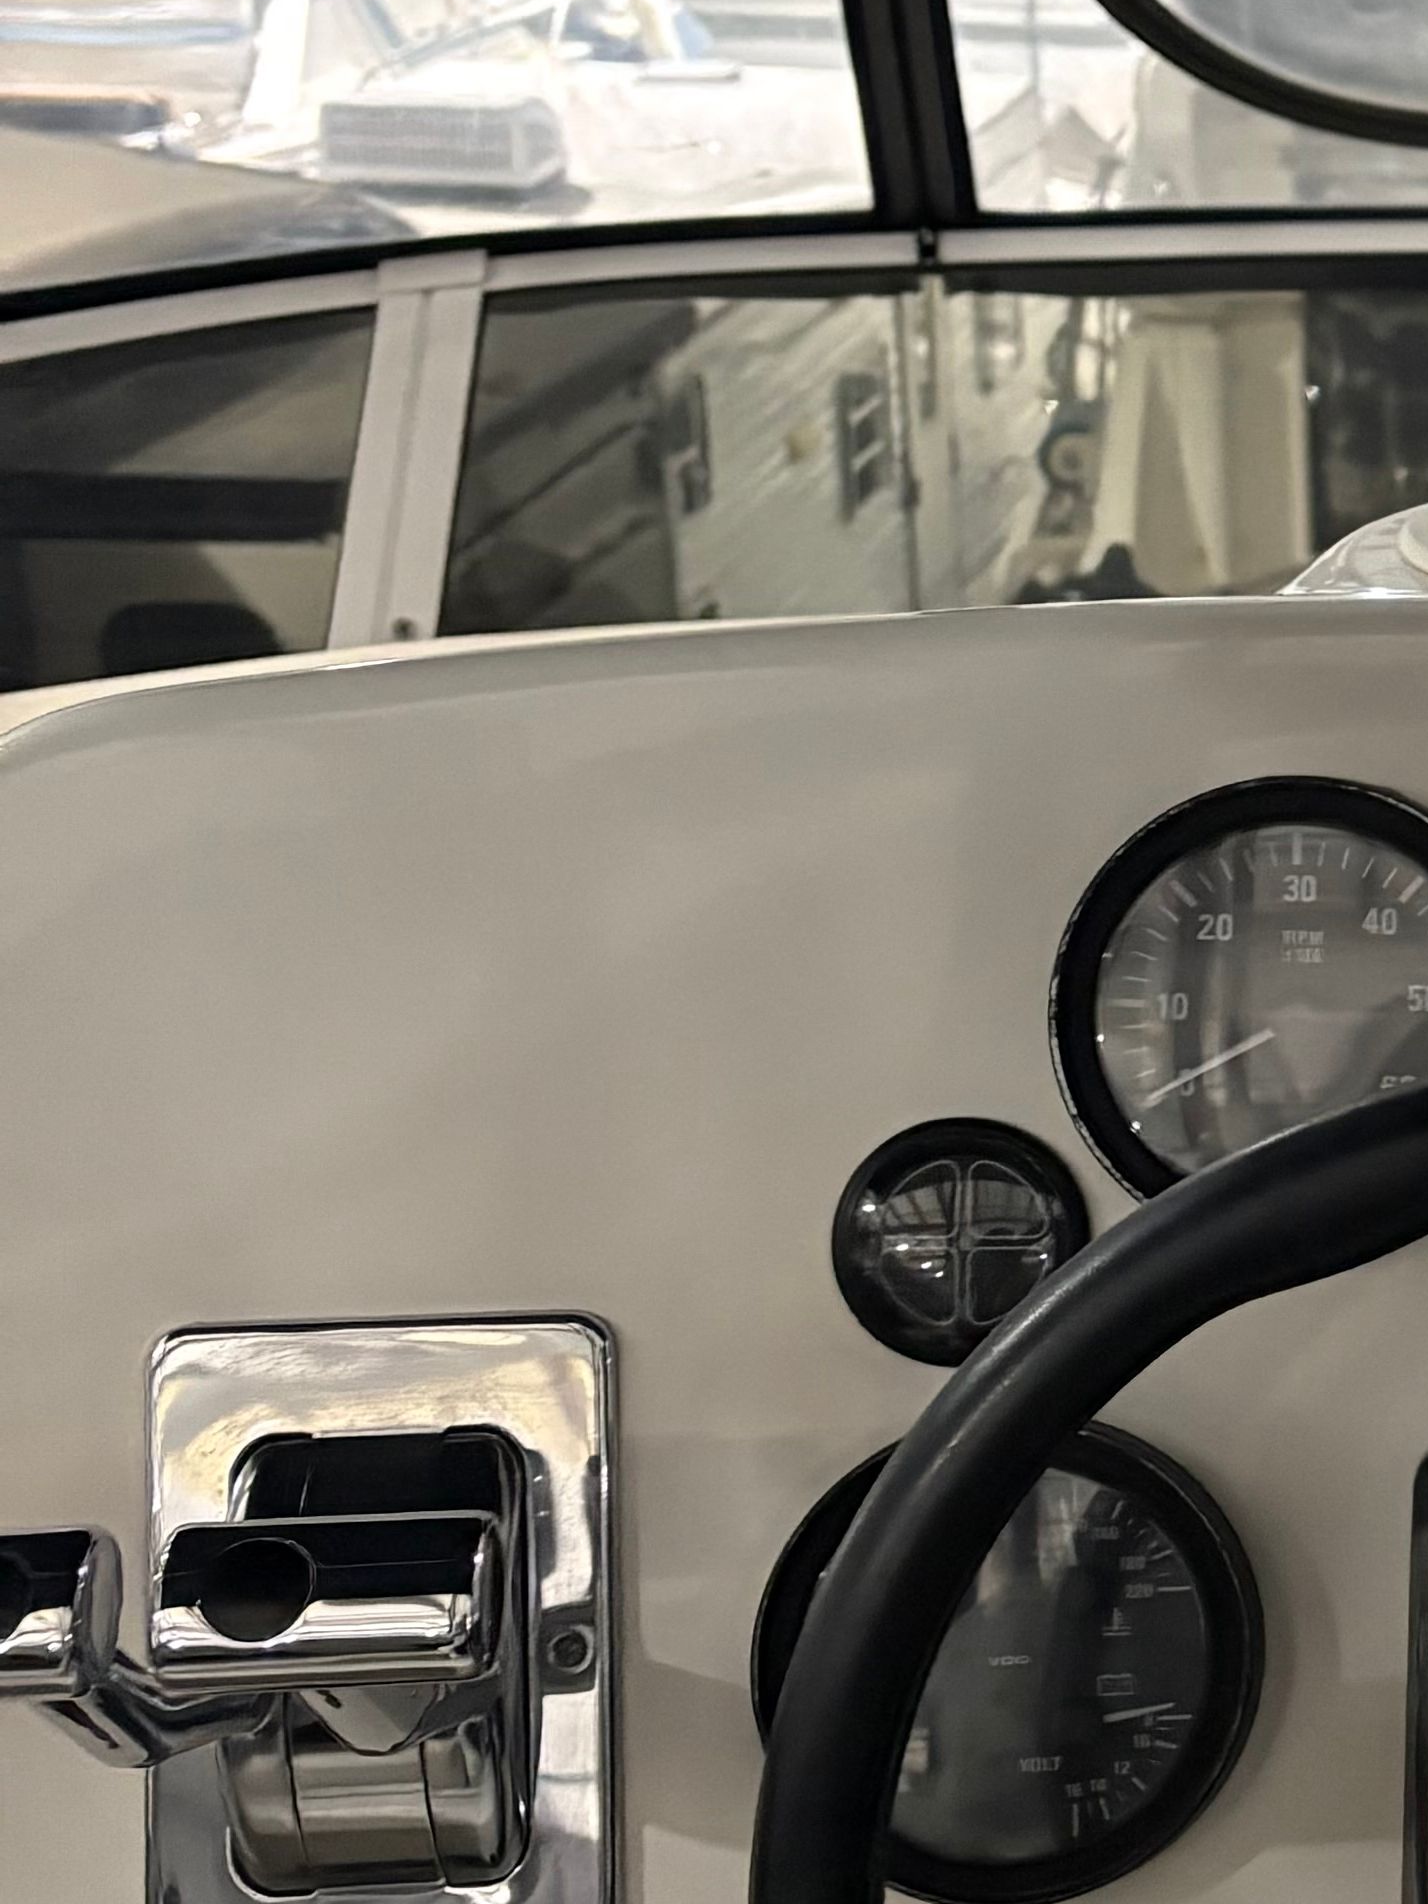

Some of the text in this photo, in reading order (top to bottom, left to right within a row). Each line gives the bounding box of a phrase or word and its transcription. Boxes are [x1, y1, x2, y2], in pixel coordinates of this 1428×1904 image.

[1282, 875, 1317, 903] 30
[1197, 913, 1233, 941] 20
[1362, 909, 1398, 935] 40
[1158, 993, 1189, 1021] 10
